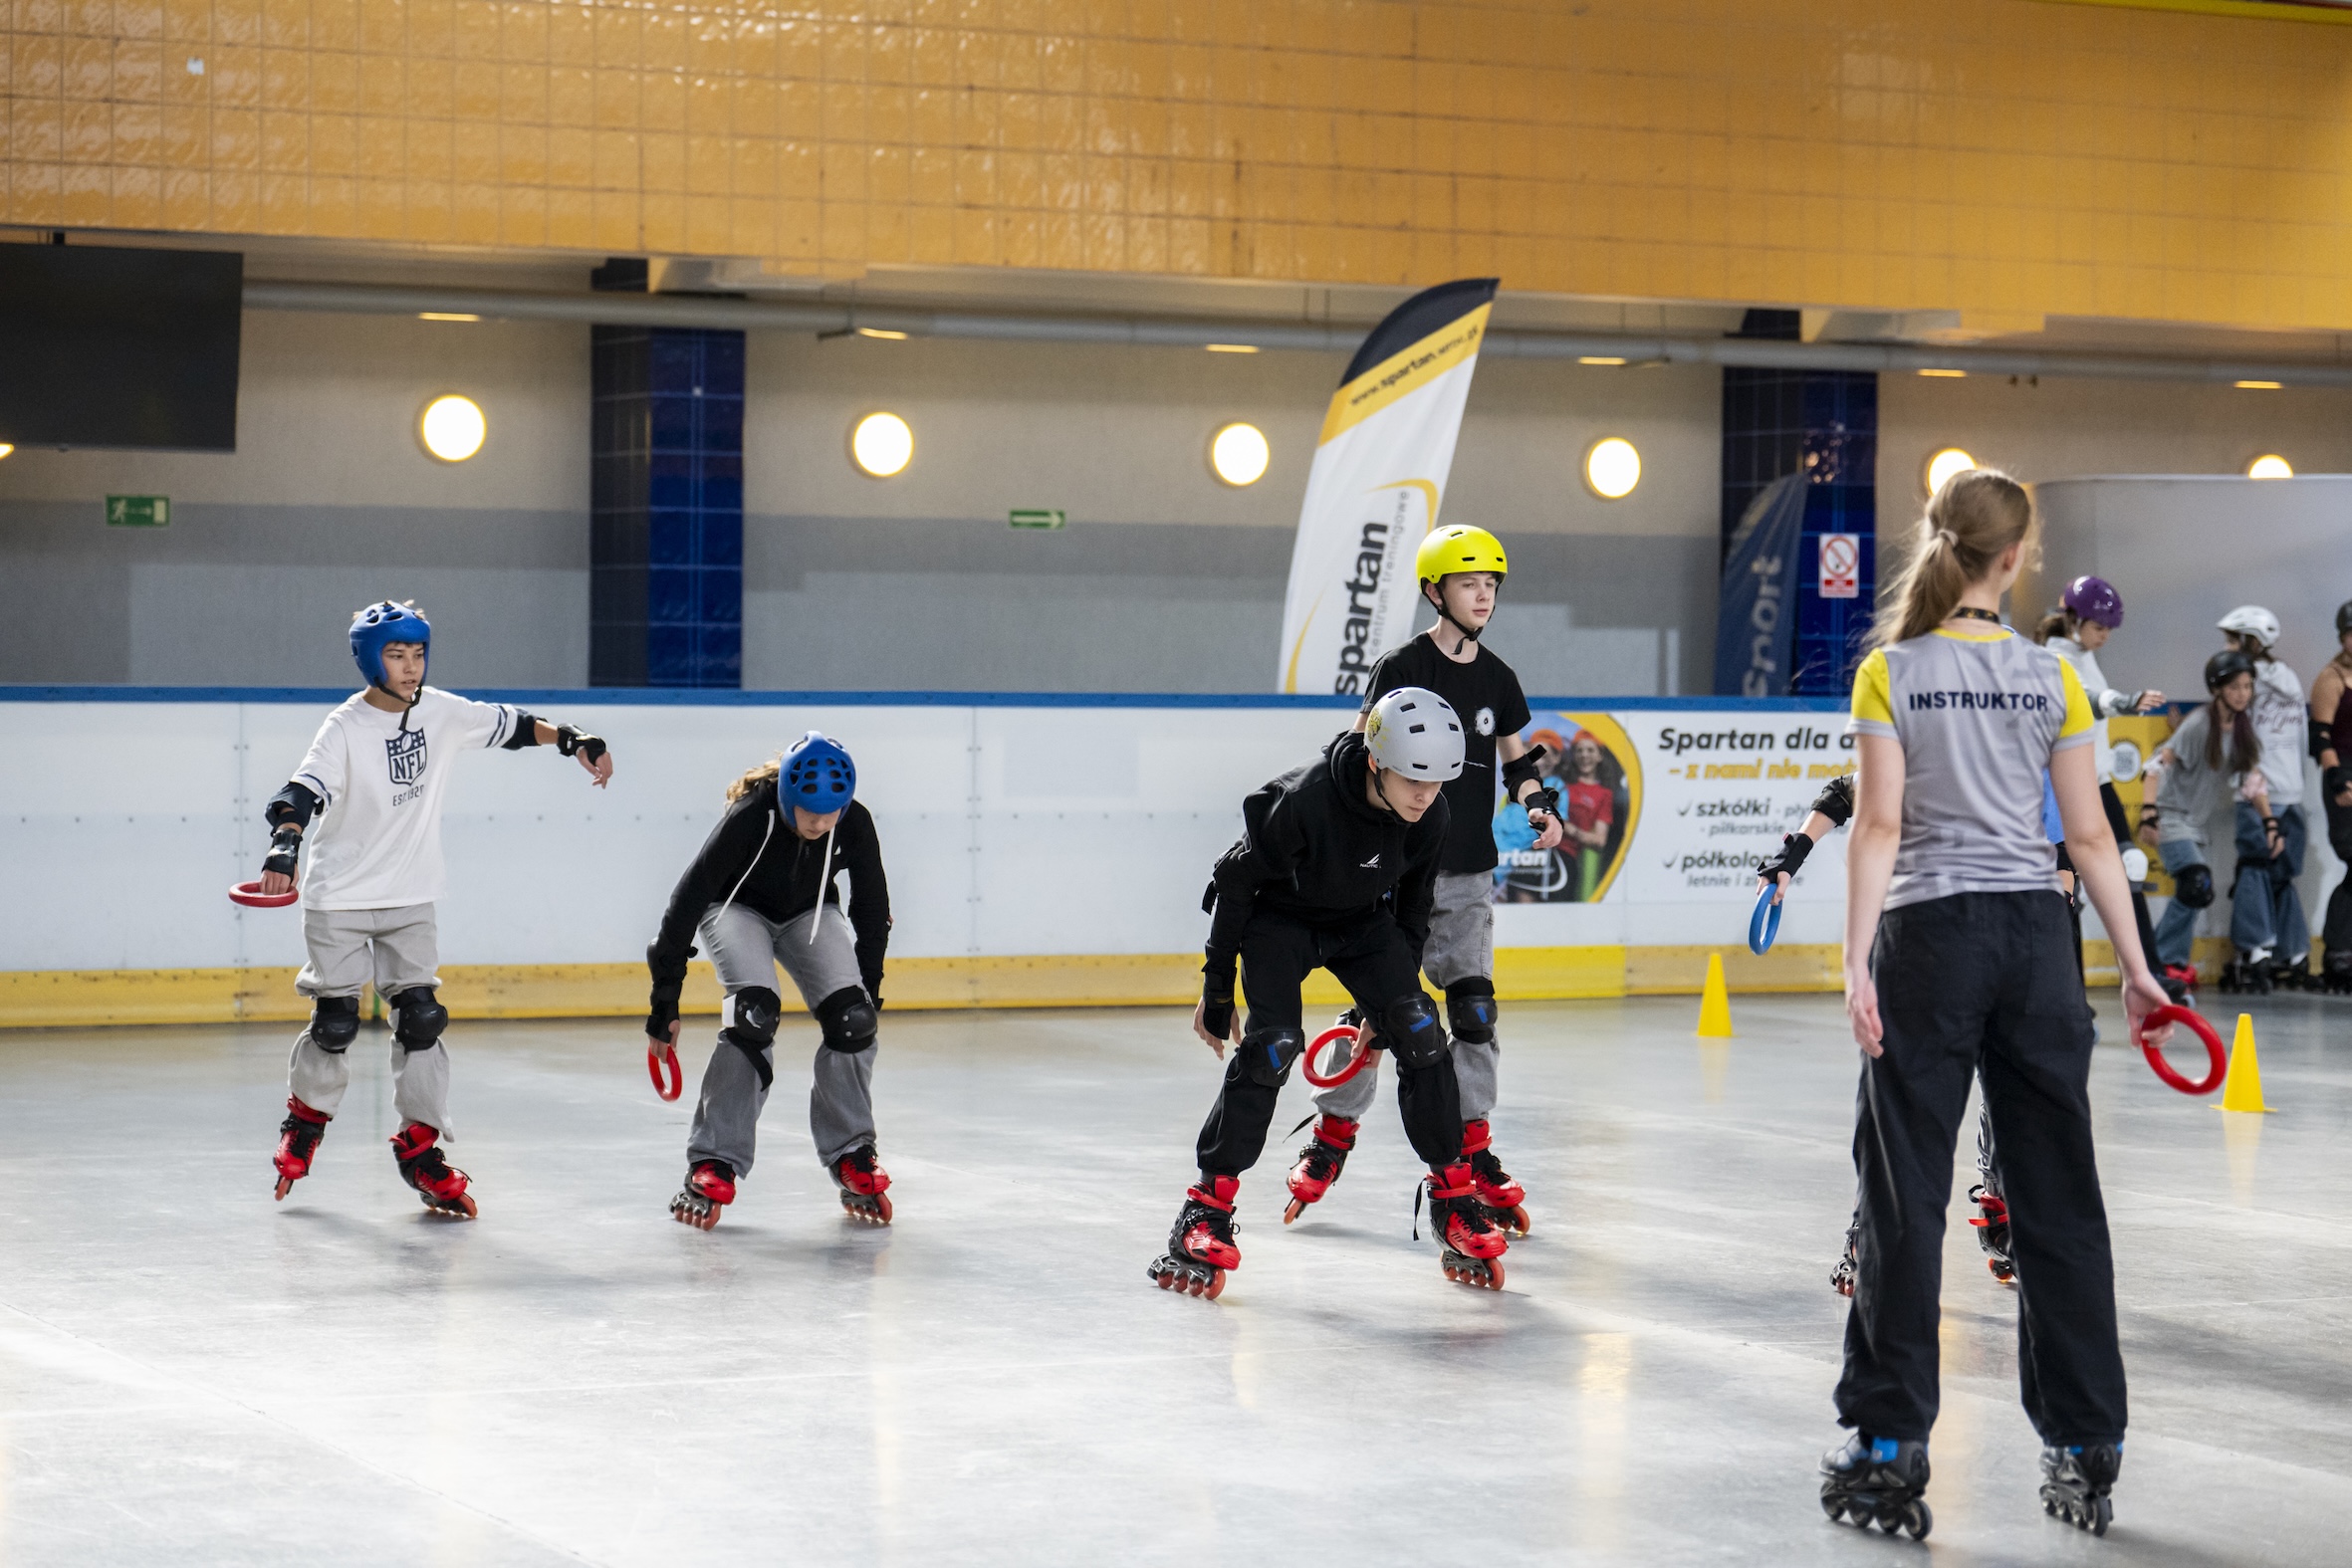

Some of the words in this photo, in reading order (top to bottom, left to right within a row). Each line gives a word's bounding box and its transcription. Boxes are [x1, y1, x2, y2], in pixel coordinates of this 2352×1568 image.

[1370, 587, 1390, 657] centrum
[1381, 491, 1409, 582] treningowe
[1335, 523, 1389, 695] spartan
[1909, 691, 2048, 712] INSTRUKTOR
[1659, 728, 1775, 756] Spartan
[1785, 727, 1830, 750] dla
[392, 750, 424, 780] NFL
[1686, 764, 1699, 780] z
[1704, 757, 1763, 780] nami
[1767, 757, 1801, 780] nie
[1697, 797, 1771, 817] szkółki
[1710, 821, 1785, 837] piłkarskie
[1688, 873, 1733, 887] letnie
